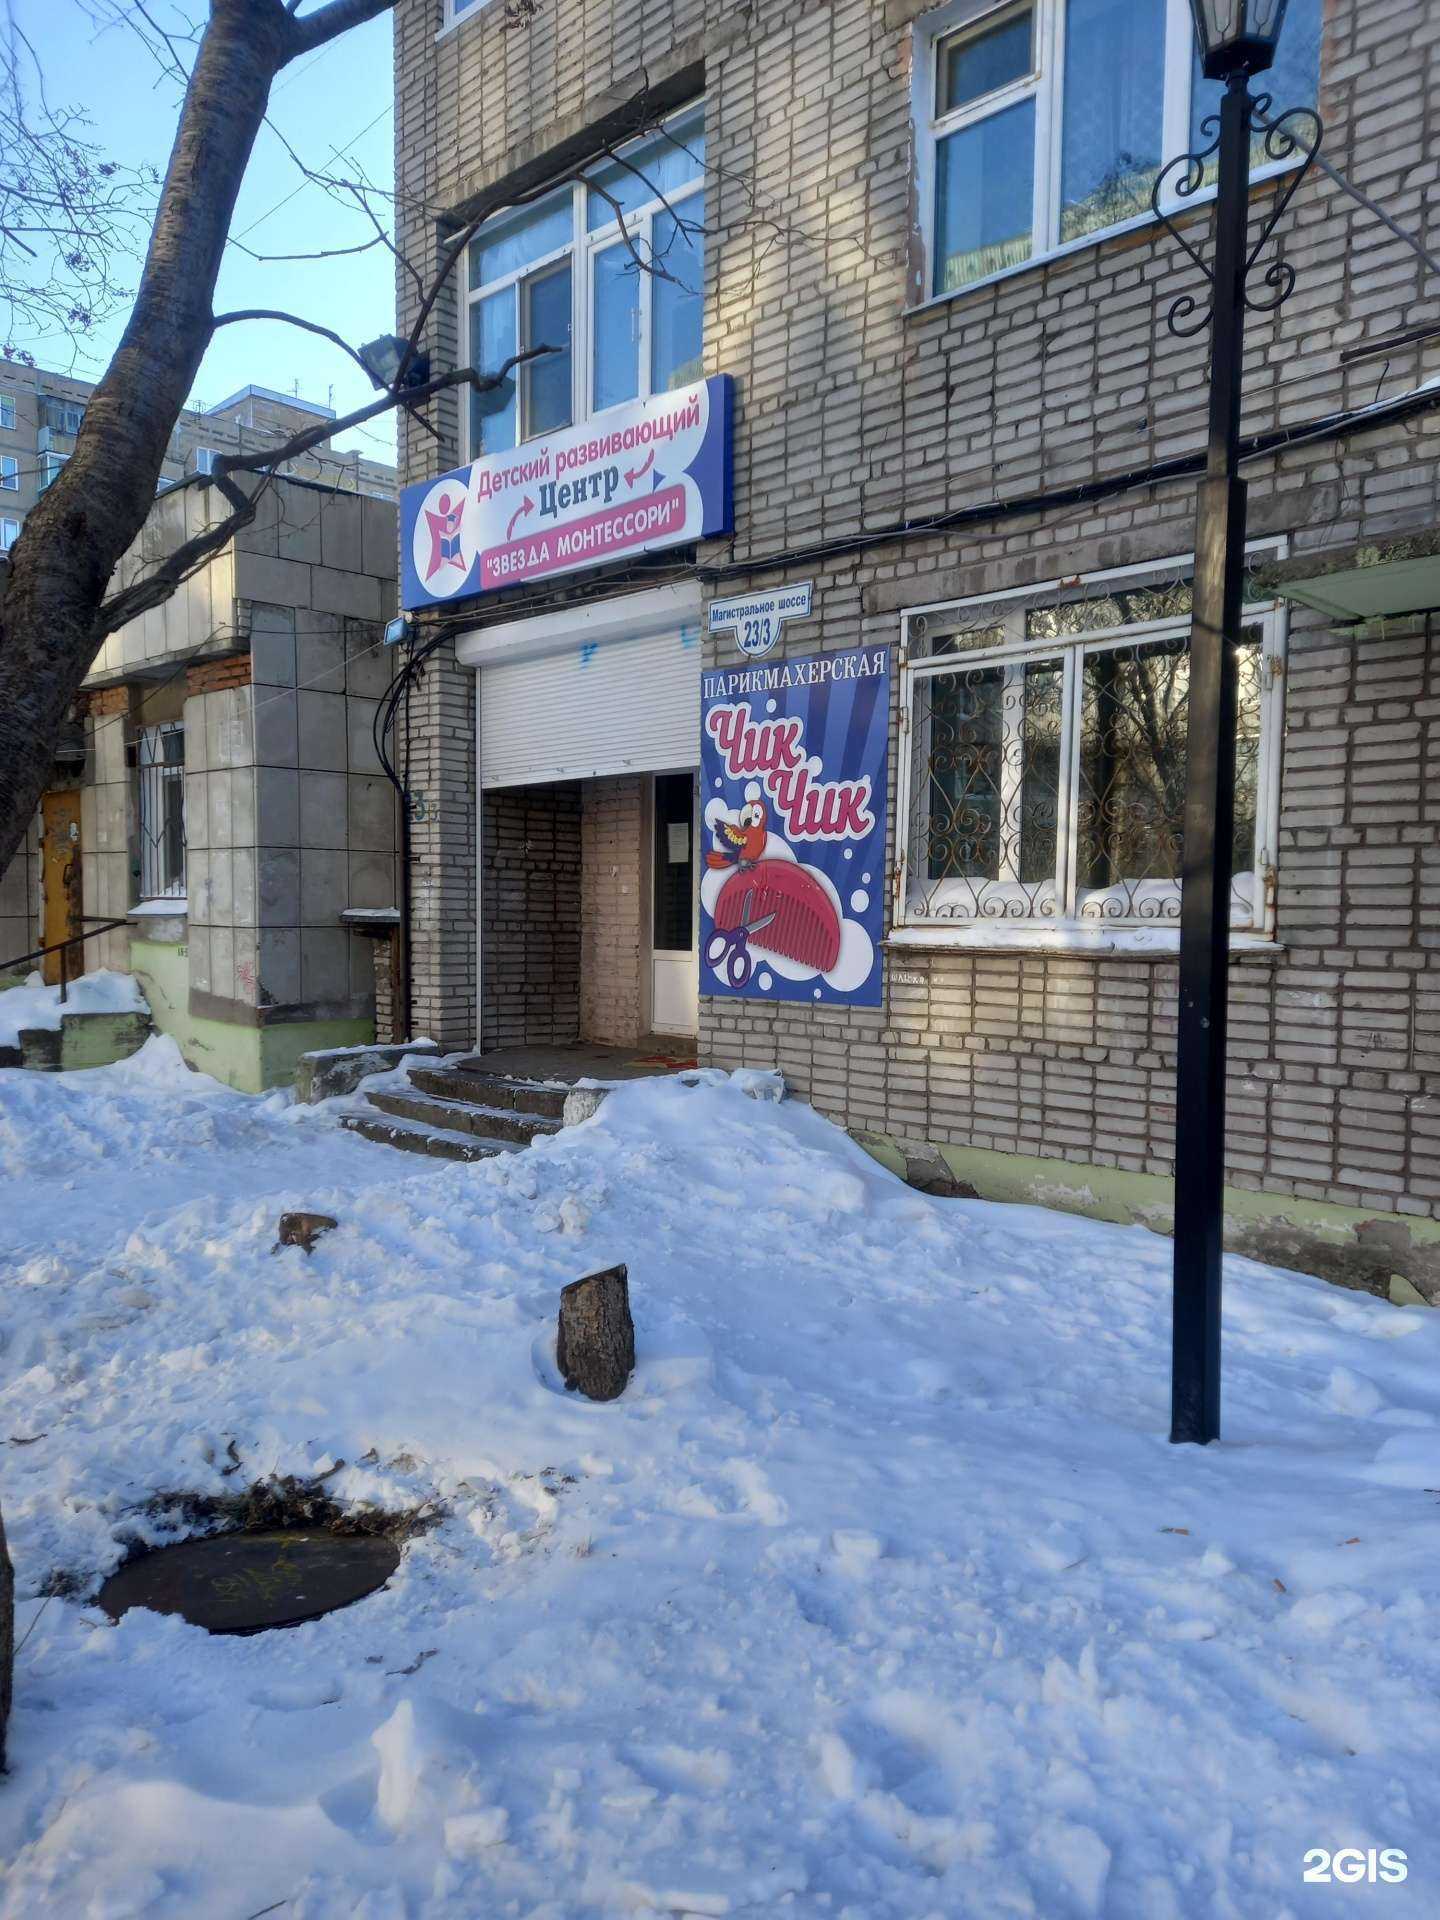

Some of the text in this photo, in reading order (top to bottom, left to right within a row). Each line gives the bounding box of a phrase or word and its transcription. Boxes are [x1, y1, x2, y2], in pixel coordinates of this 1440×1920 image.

[477, 394, 700, 503] Детский развивающий
[539, 465, 619, 519] Центр
[712, 594, 806, 621] Магистральное шоссе
[743, 617, 771, 648] 23/3
[703, 650, 886, 699] ПАРИКМАХЕРСКАЯ
[709, 709, 802, 774] Чик
[768, 769, 870, 835] Чик
